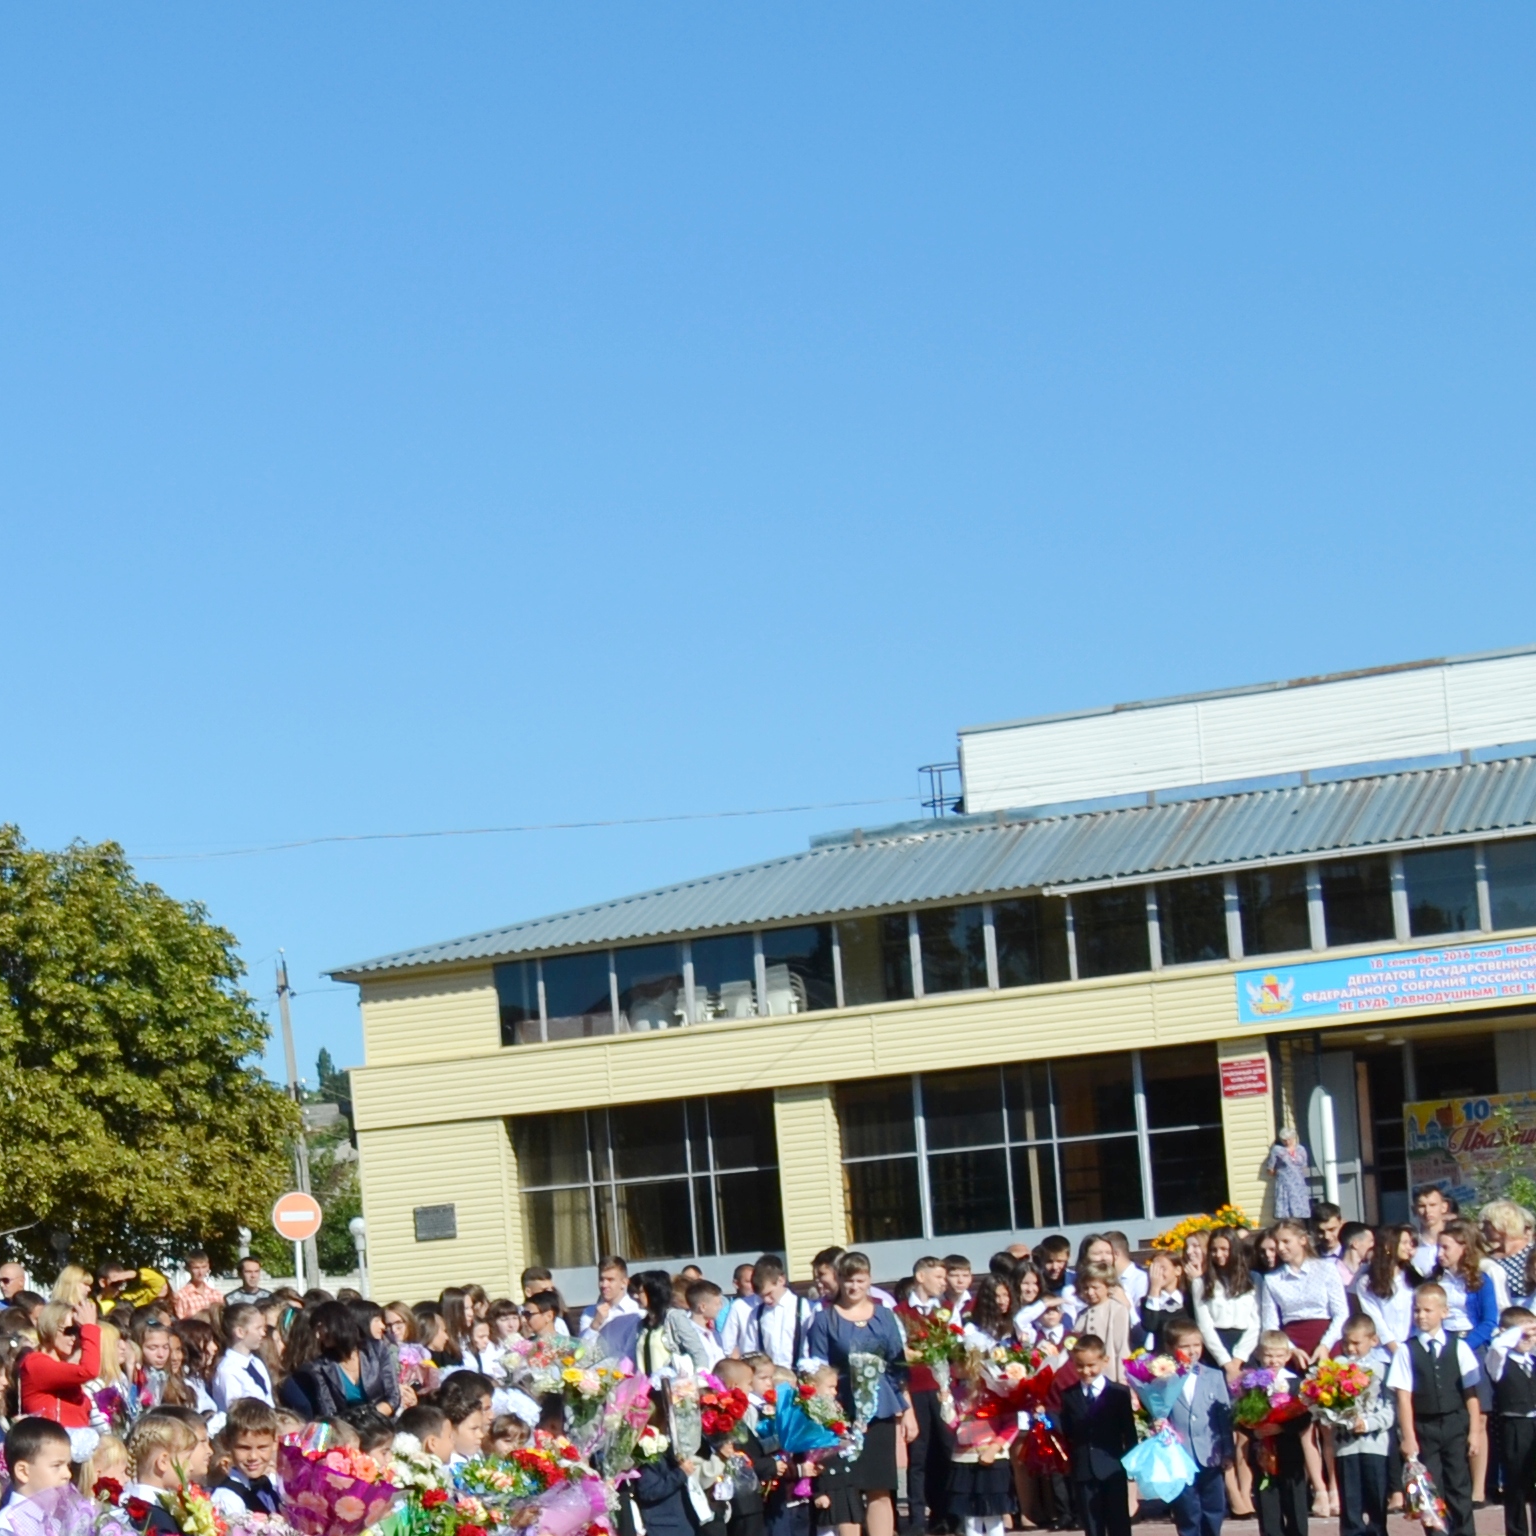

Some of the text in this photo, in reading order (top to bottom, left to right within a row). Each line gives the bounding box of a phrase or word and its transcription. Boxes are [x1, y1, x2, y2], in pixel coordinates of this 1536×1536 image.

[1371, 960, 1384, 968] 18
[1388, 956, 1439, 967] сентября
[1443, 951, 1471, 961] 2016
[1475, 950, 1502, 958] года
[1302, 969, 1536, 1003] ФЕДЕРАЛЬНОГО СОБРАНИЯ РОССИЙСК
[1348, 971, 1416, 987] ДЕПУТАТОВ
[1339, 983, 1536, 1011] НЕ БУДЬ РАВНОДУШНЫМ! ВСЕ Н
[1463, 1100, 1489, 1120] 10
